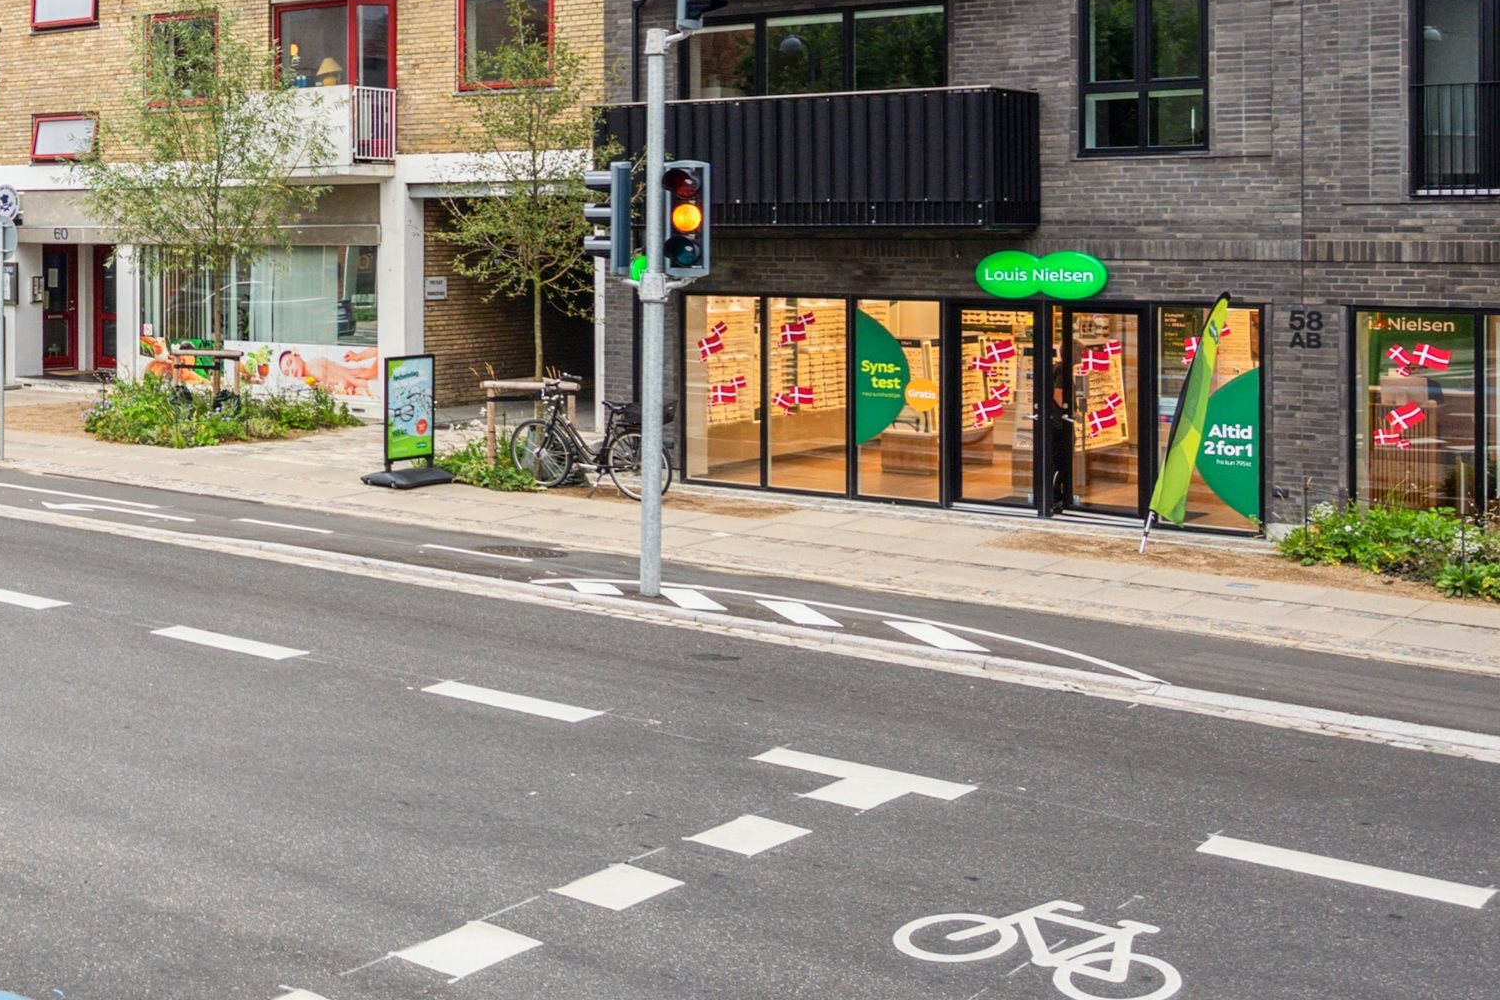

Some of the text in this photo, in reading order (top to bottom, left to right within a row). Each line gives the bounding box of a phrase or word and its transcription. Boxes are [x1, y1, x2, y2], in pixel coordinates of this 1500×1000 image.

[53, 227, 69, 240] 60
[984, 267, 1094, 283] Louis Nielsen
[1289, 310, 1323, 331] 58
[1387, 316, 1455, 333] Nielsen
[1289, 332, 1322, 349] AB
[861, 359, 901, 376] Syns-
[870, 376, 901, 389] test
[907, 388, 936, 400] Gratis
[1208, 423, 1253, 440] Altid
